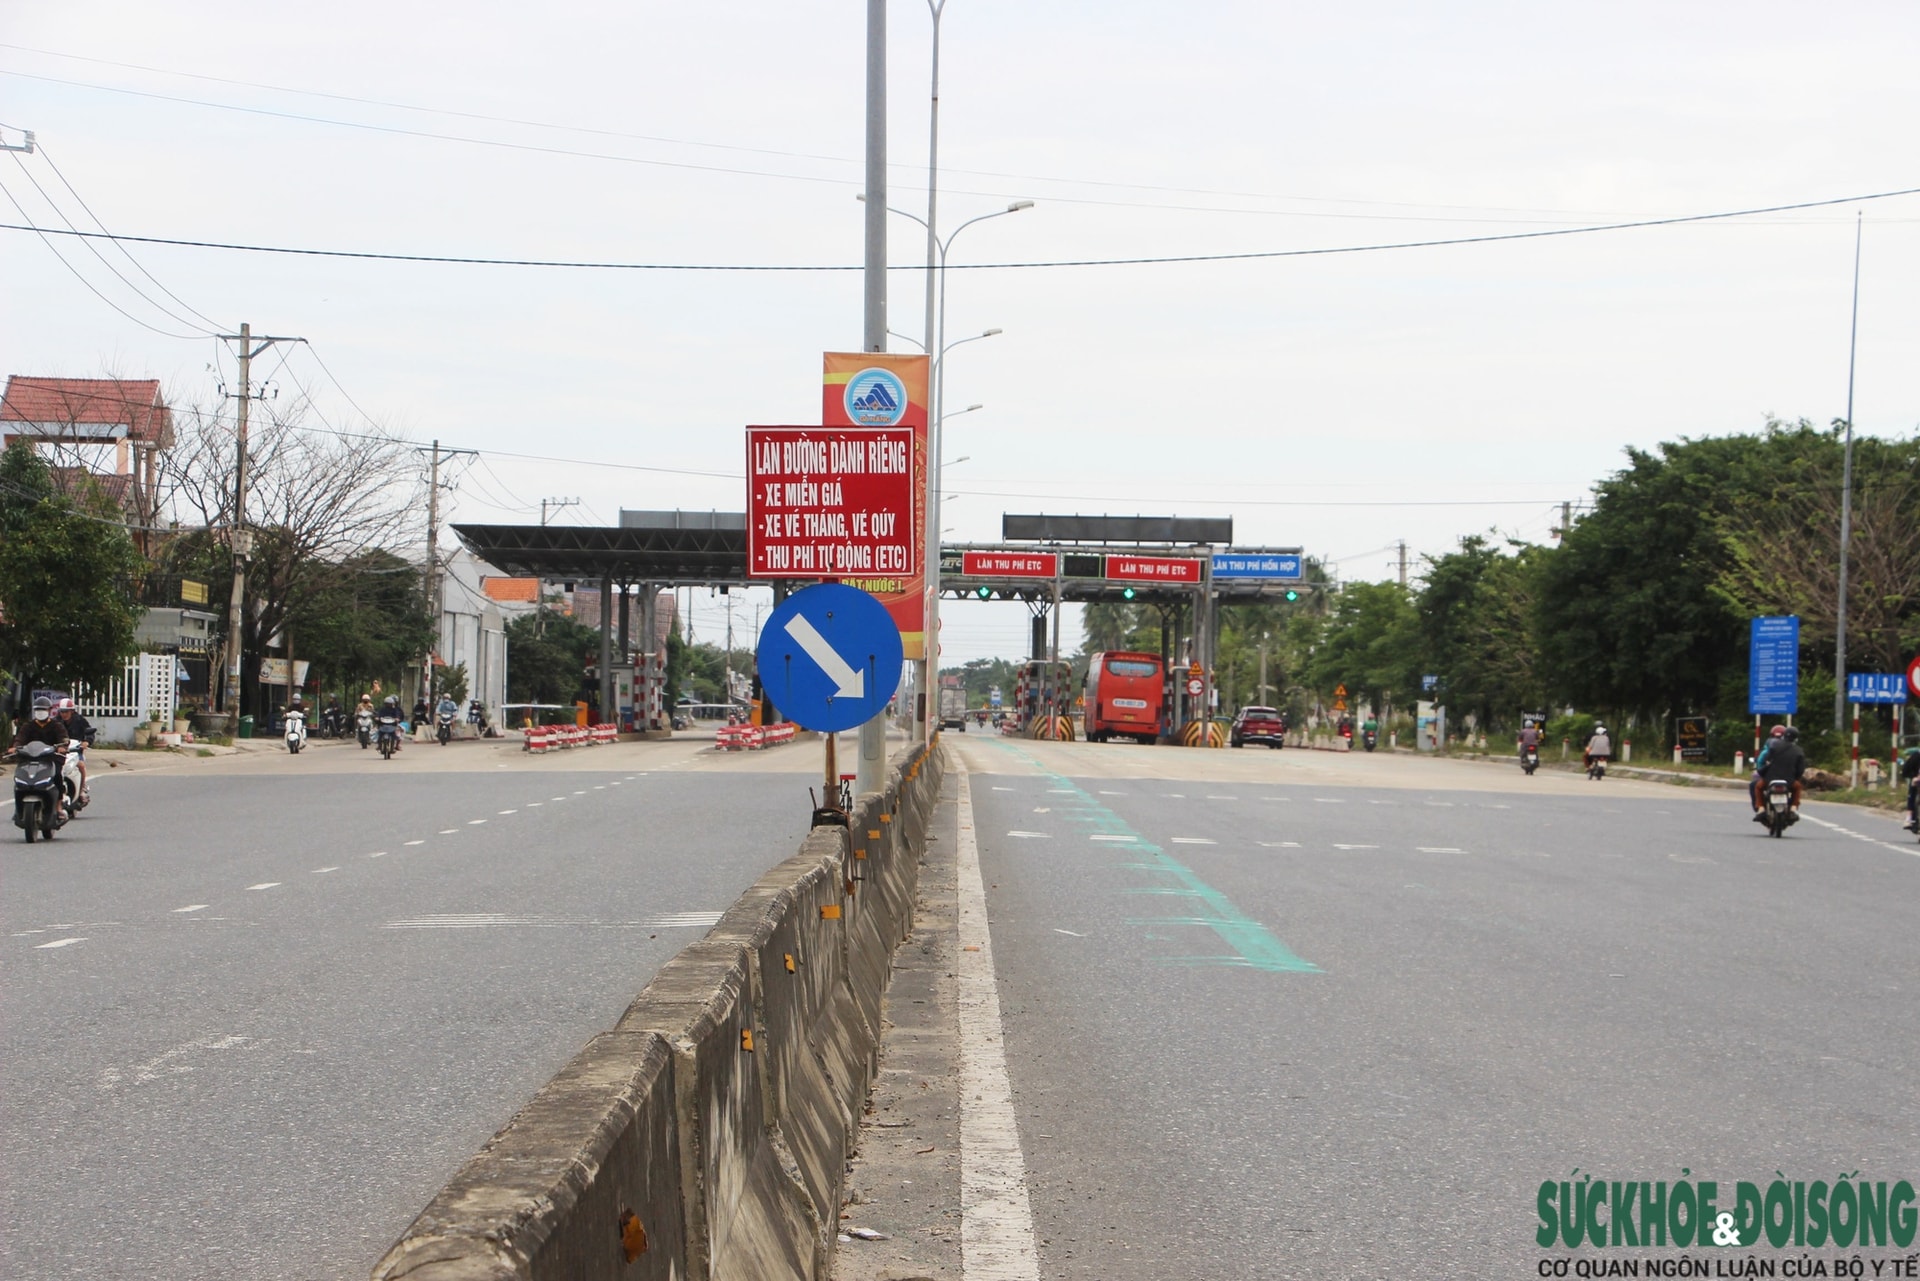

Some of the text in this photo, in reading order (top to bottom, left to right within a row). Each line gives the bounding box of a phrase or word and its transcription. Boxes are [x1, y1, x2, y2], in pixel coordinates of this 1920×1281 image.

[756, 436, 780, 474] LÀN
[784, 432, 826, 474] ĐƯỜNG
[830, 435, 865, 474] DÀNH
[765, 484, 781, 506] XE
[785, 475, 818, 506] MIỄN
[822, 477, 843, 506] GIÁ
[765, 514, 781, 537] XE
[785, 509, 799, 537] VÉ
[804, 508, 848, 539] THÁNG,
[852, 509, 867, 536] VÉ
[872, 508, 895, 538] QÚY
[766, 546, 789, 568] THU
[794, 540, 815, 568] PHÍ
[818, 543, 834, 572] TỰ
[836, 541, 870, 572] ĐỘNG
[876, 545, 907, 571] (ETC)
[977, 558, 1042, 570] LÀN THU PHÍ ETC
[1120, 562, 1187, 575] LÀN THU PHÍ ETC
[1212, 559, 1227, 570] LÀN
[1229, 561, 1245, 570] THU
[1247, 560, 1260, 570] PHÍ
